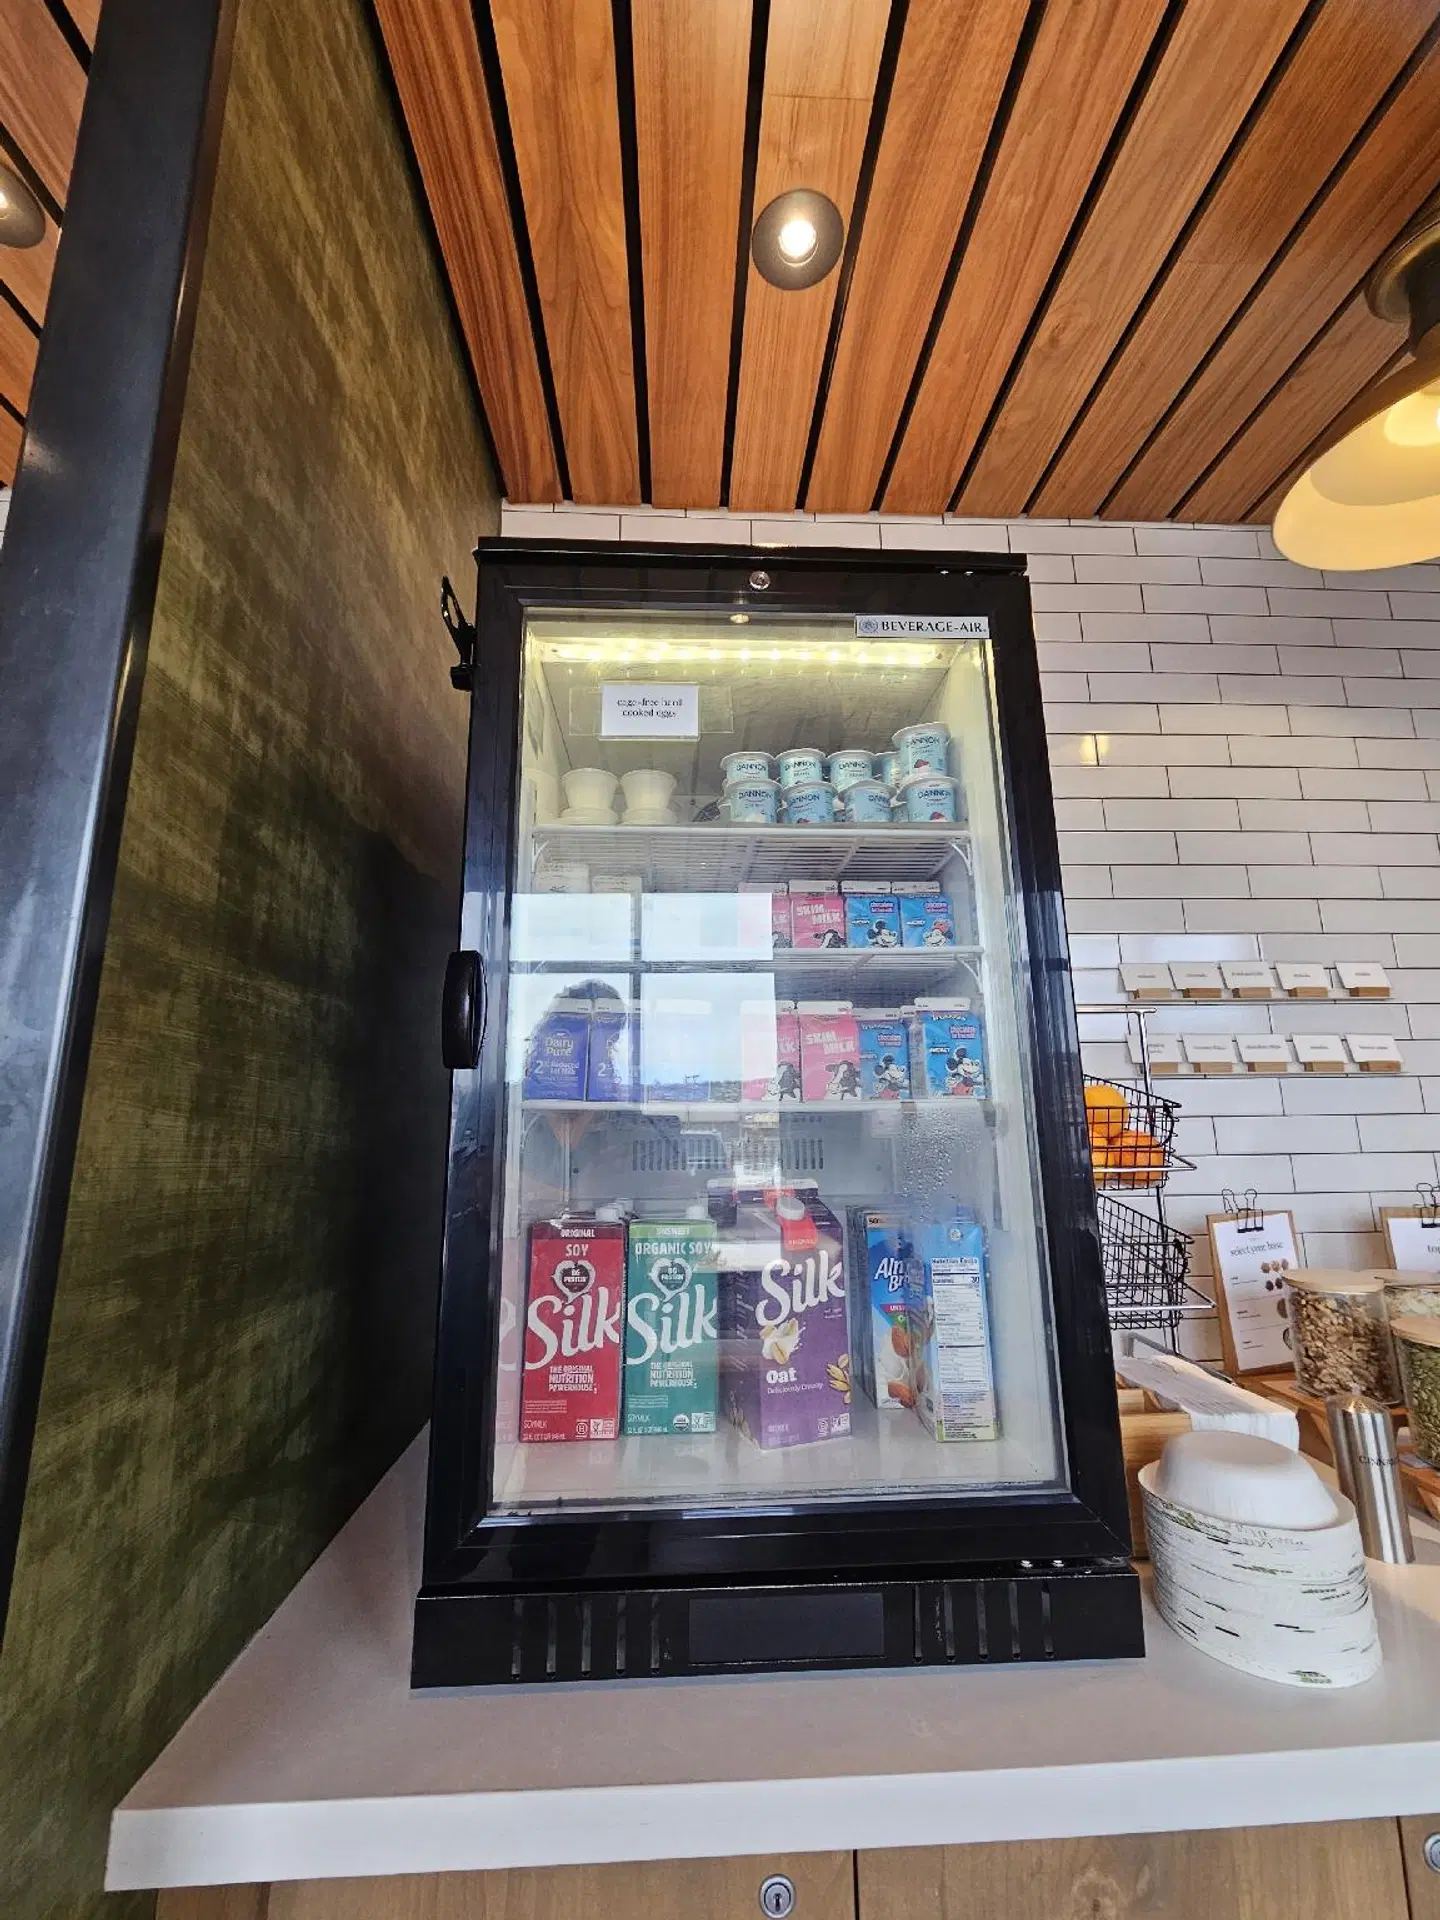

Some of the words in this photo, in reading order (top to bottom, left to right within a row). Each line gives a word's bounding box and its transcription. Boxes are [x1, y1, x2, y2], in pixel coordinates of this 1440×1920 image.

[738, 789, 772, 799] DANNON
[918, 788, 951, 799] DANNON
[796, 903, 825, 916] SKIM
[812, 912, 842, 925] MILK
[545, 1037, 574, 1050] Dairy
[804, 1031, 838, 1045] SKIM
[546, 1047, 572, 1056] Pure
[565, 1243, 589, 1257] SOY
[635, 1243, 687, 1255] ORGANIC
[755, 1249, 846, 1327] Silk
[525, 1286, 621, 1371] Silk
[627, 1283, 718, 1365] Silk
[549, 1366, 564, 1374] THE
[650, 1370, 694, 1380] NUTRITION
[549, 1373, 594, 1384] NUTRITION
